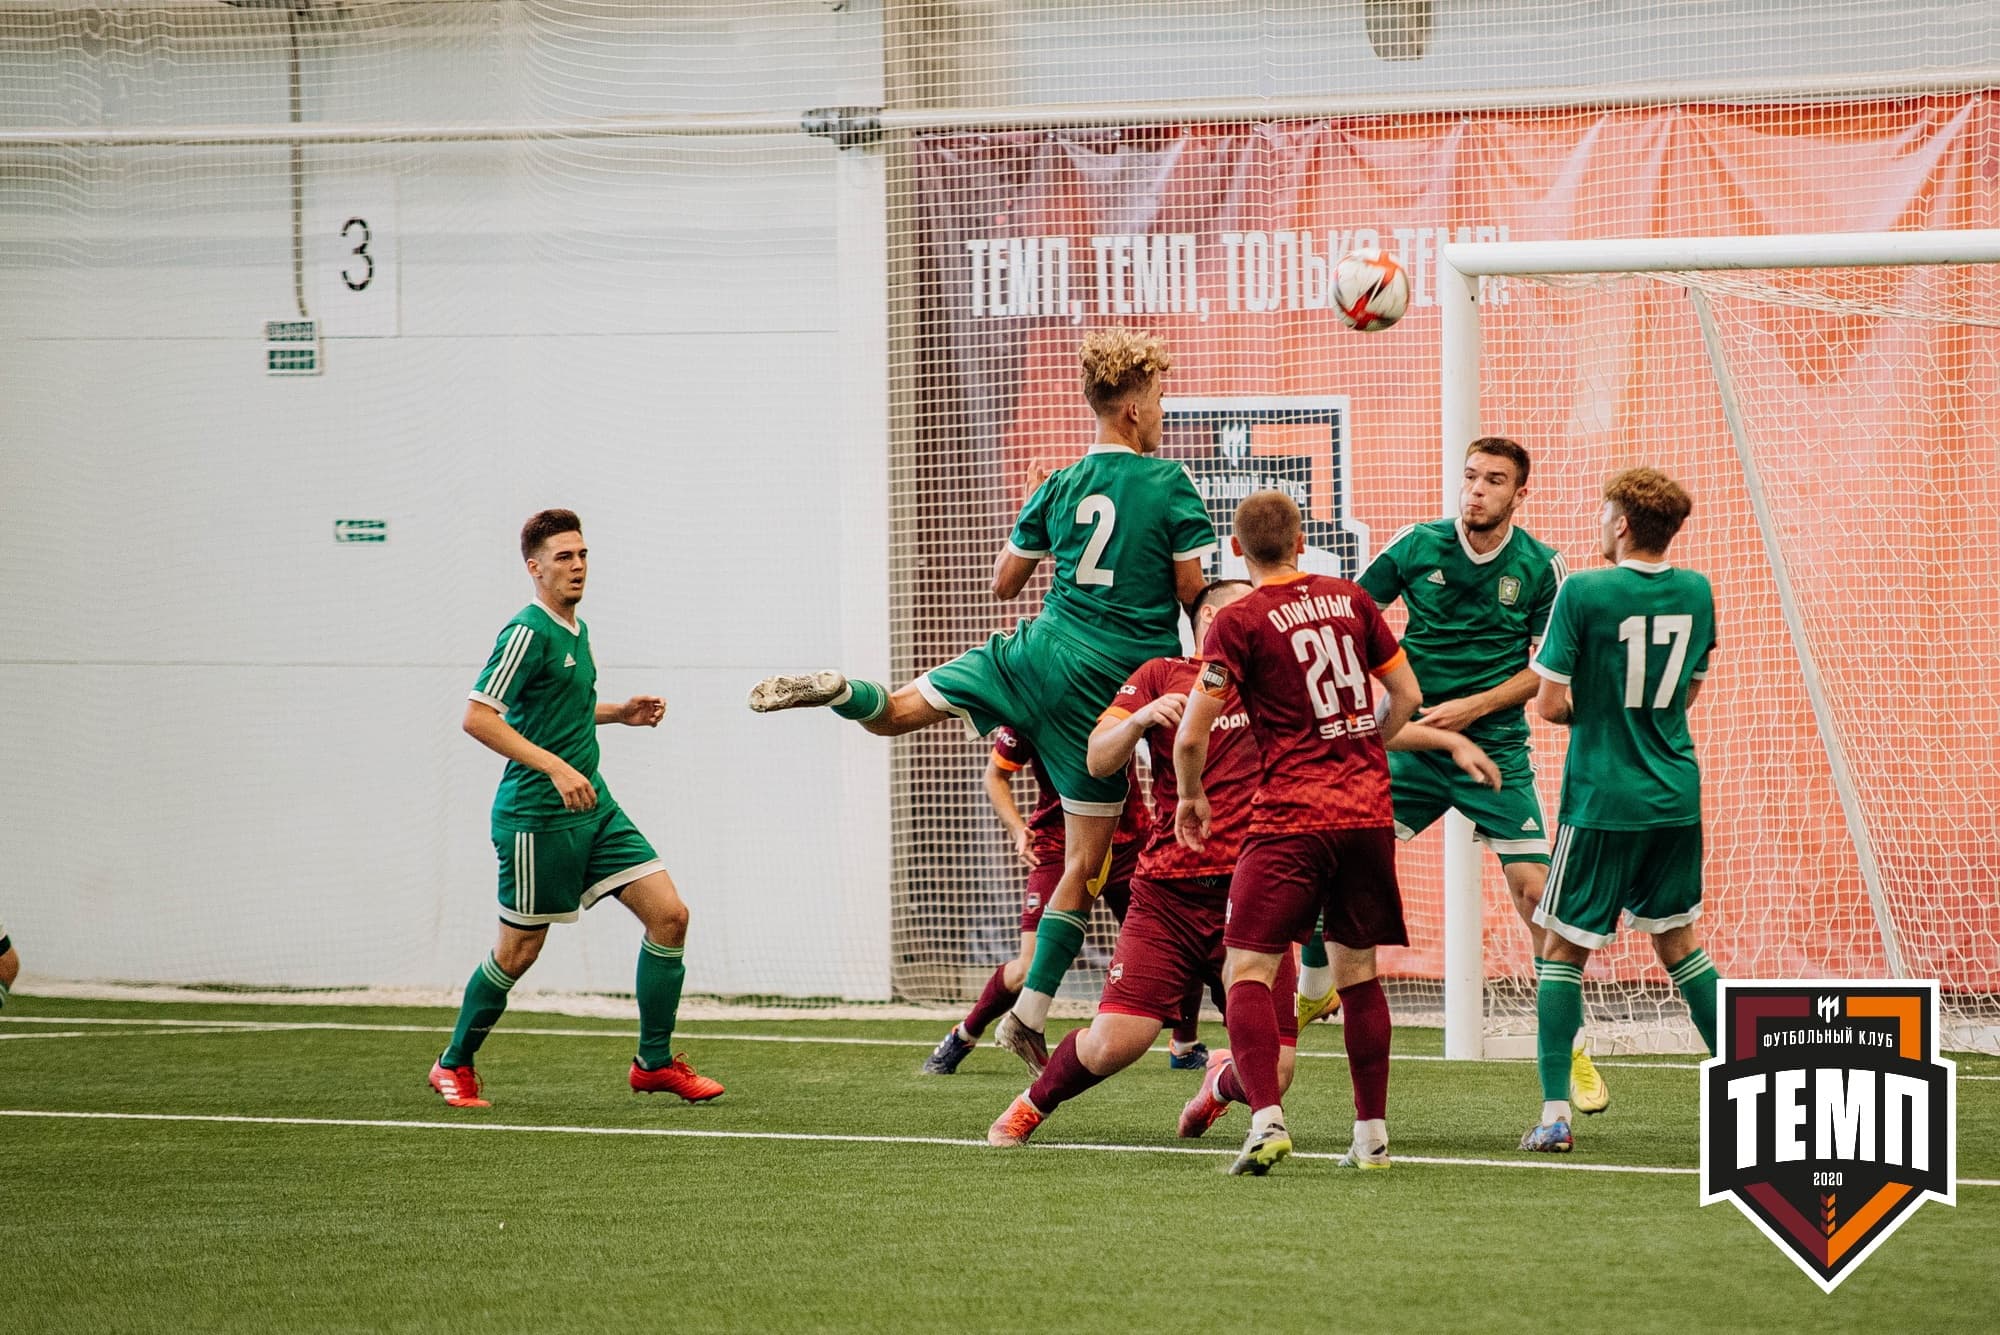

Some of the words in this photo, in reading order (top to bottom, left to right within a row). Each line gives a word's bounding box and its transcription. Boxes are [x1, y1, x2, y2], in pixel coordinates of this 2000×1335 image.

[341, 219, 373, 291] 3
[967, 238, 1083, 324] ТЕМП,
[1091, 234, 1209, 322] ТЕМП,
[1221, 229, 1380, 312] ТОЛЬК
[1075, 493, 1116, 588] 2
[1267, 593, 1355, 633] ОЛИЙНЫК
[1291, 625, 1368, 719] 24
[1618, 614, 1693, 709] 17
